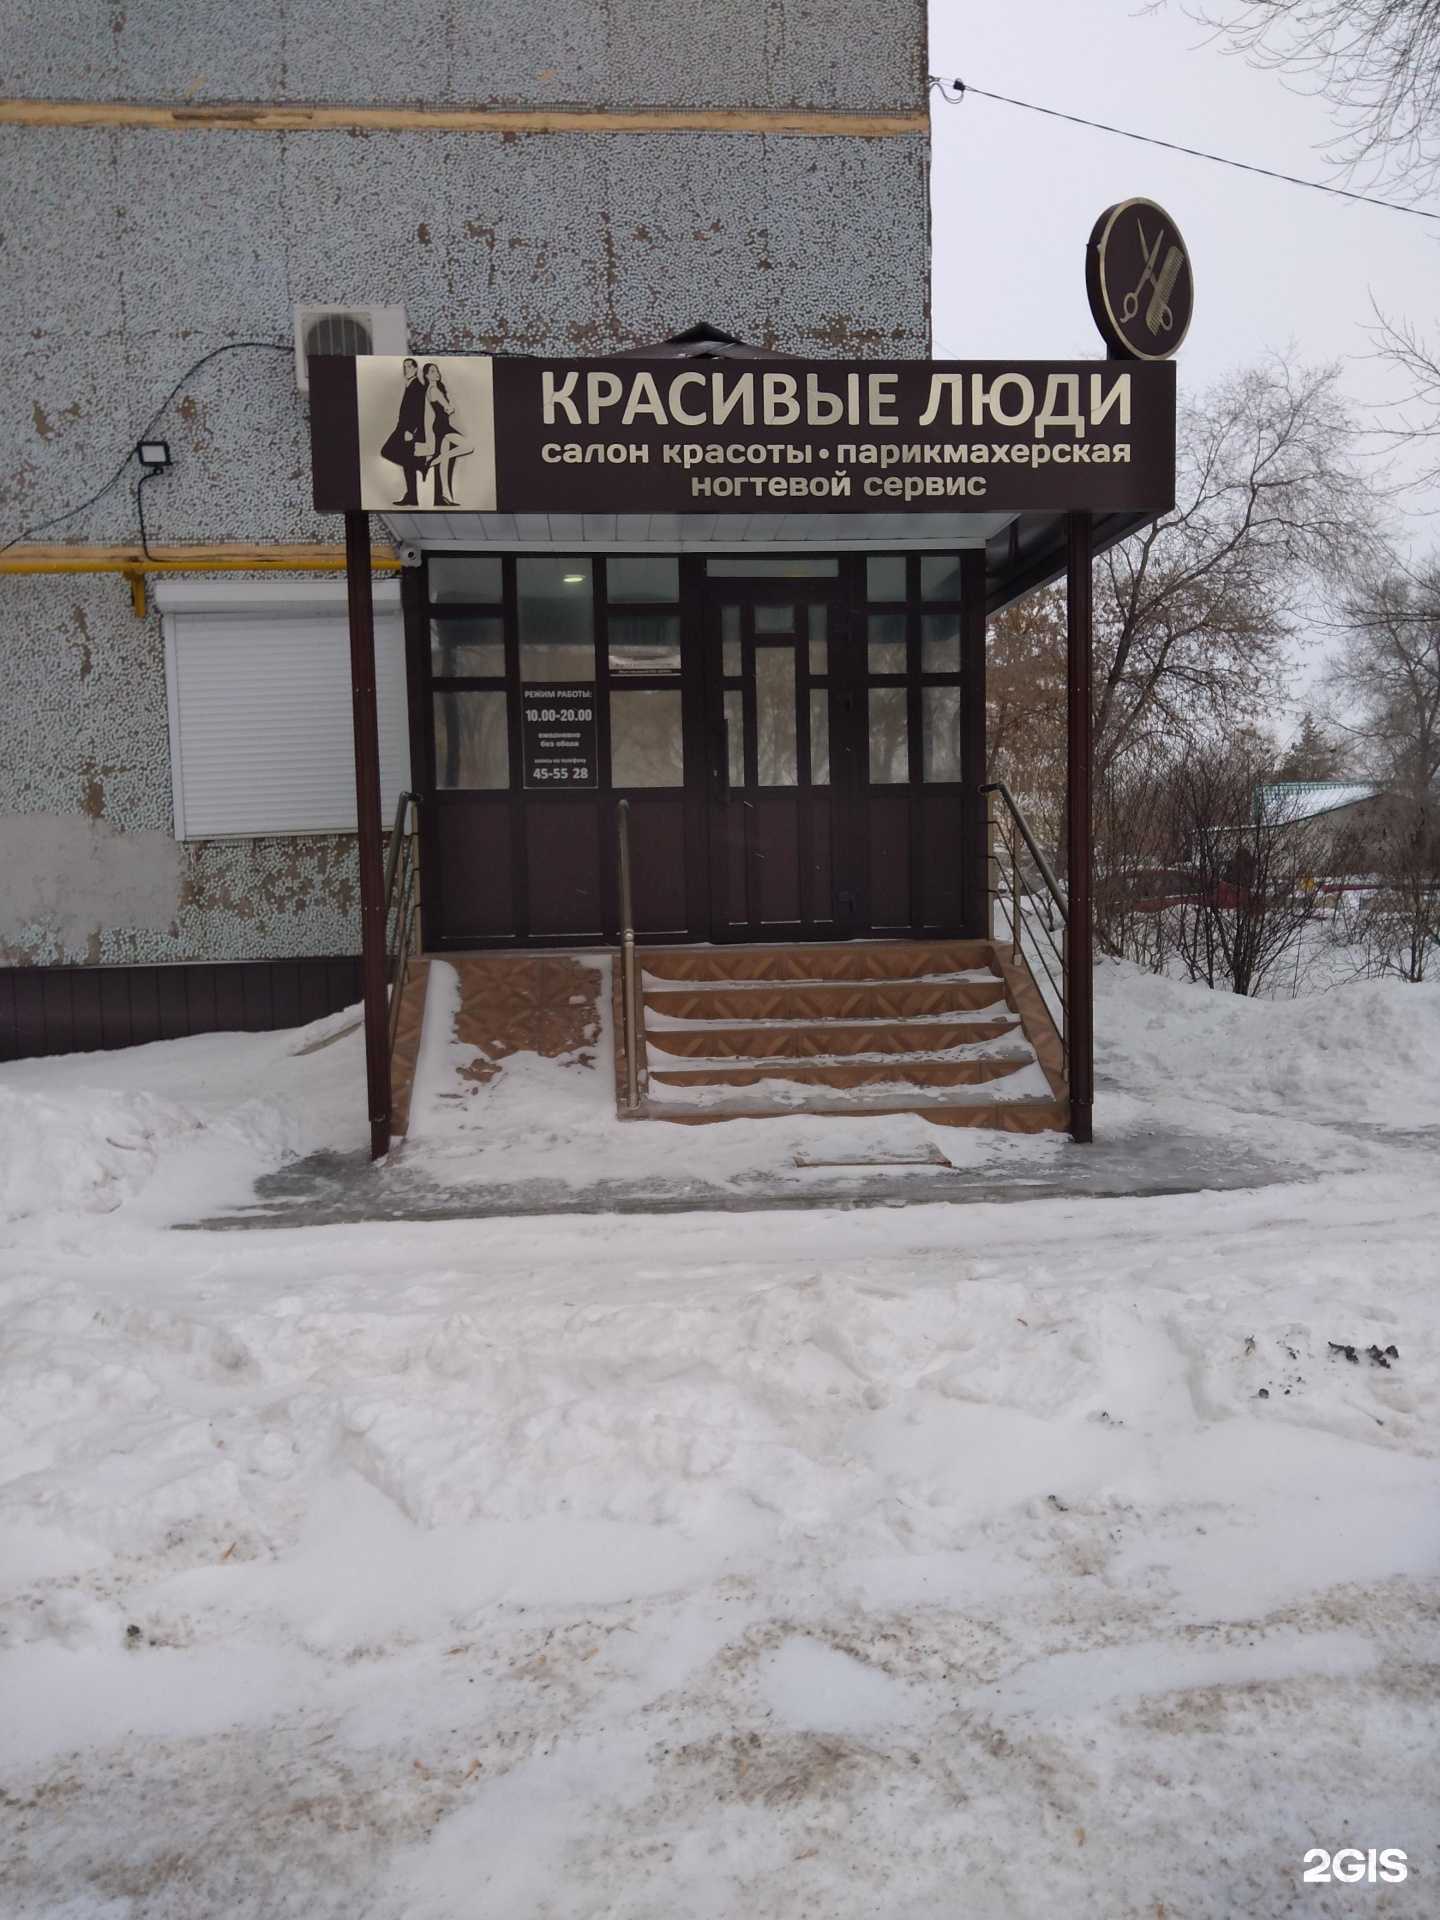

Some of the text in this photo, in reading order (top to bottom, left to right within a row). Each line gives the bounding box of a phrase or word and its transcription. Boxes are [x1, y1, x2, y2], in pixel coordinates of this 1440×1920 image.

[541, 371, 1131, 439] КРАСИВЫЕ ЛЮДИ
[541, 443, 1131, 469] салон красоты парикмахерская
[691, 471, 987, 502] ногтевой сервис
[524, 690, 555, 698] РЕЖИМ
[525, 708, 592, 722] 10.00-20.00
[533, 768, 588, 779] 45-55 28
